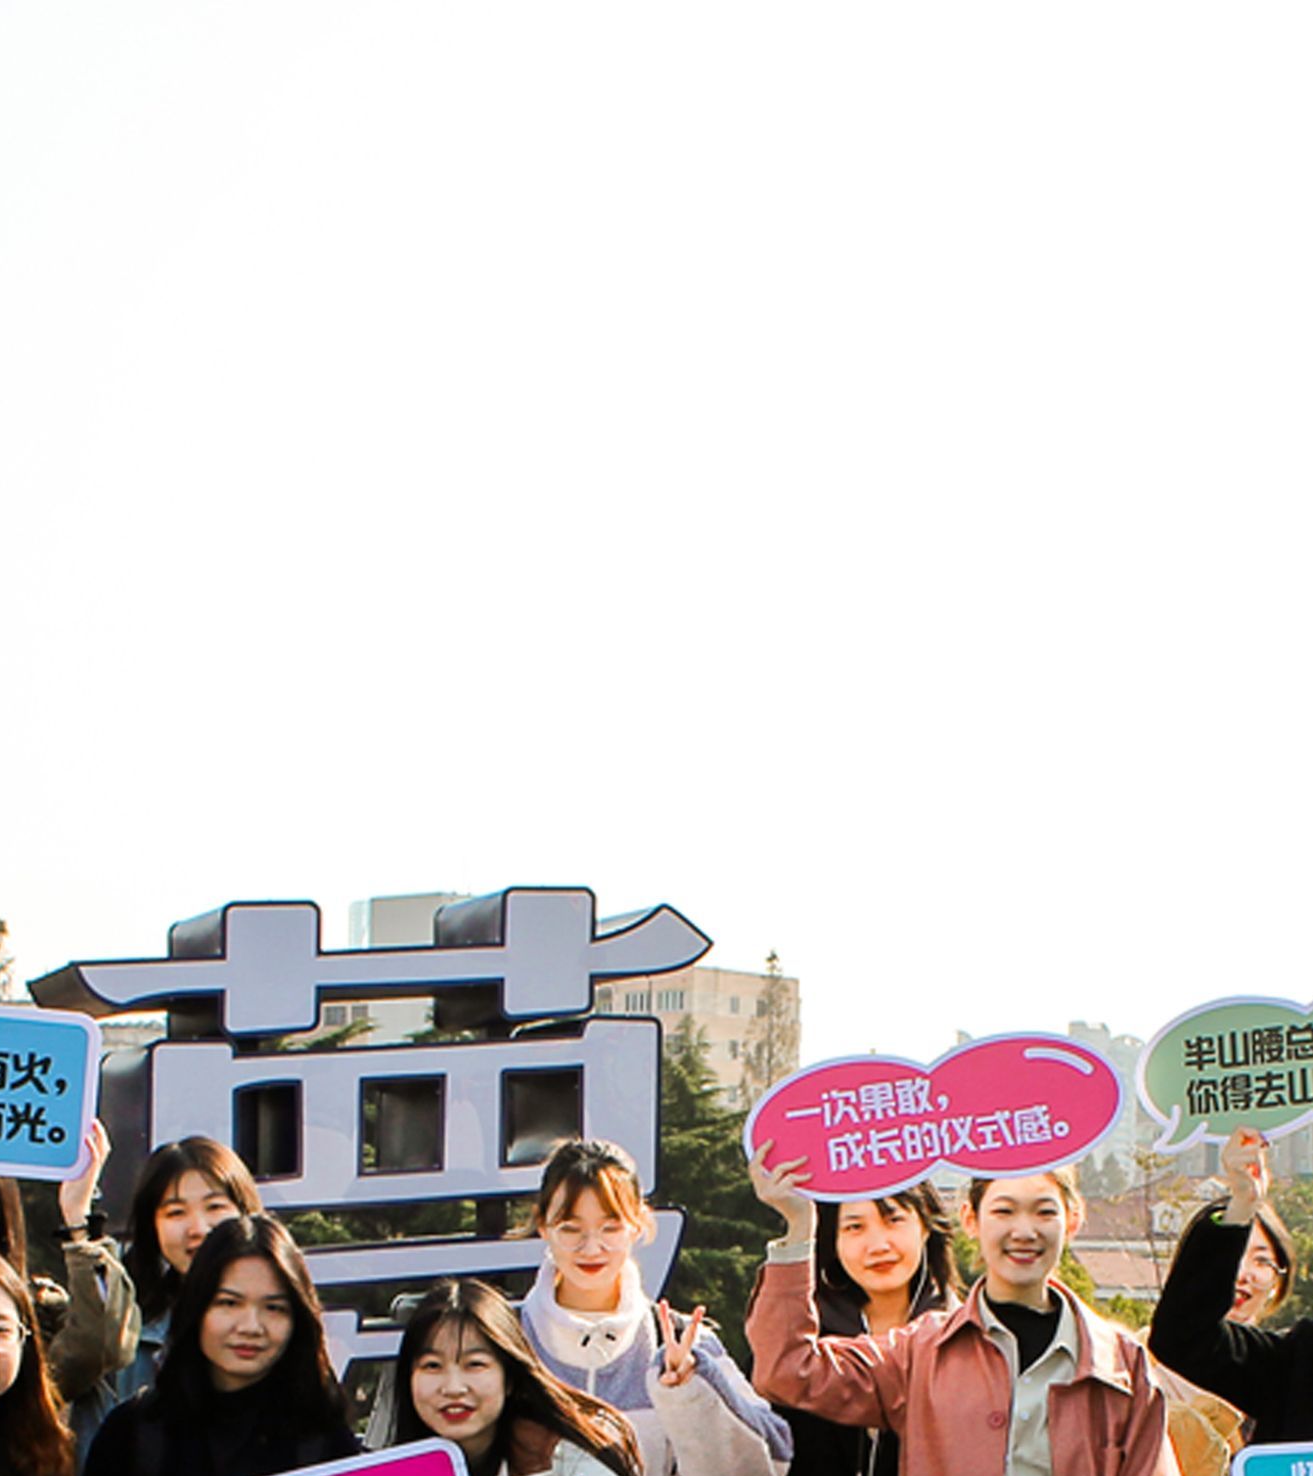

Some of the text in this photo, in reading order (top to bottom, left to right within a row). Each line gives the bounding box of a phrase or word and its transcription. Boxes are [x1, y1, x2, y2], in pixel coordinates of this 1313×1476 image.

[785, 1076, 950, 1131] 一次果敢，
[827, 1105, 1072, 1174] 成长的仪式感。
